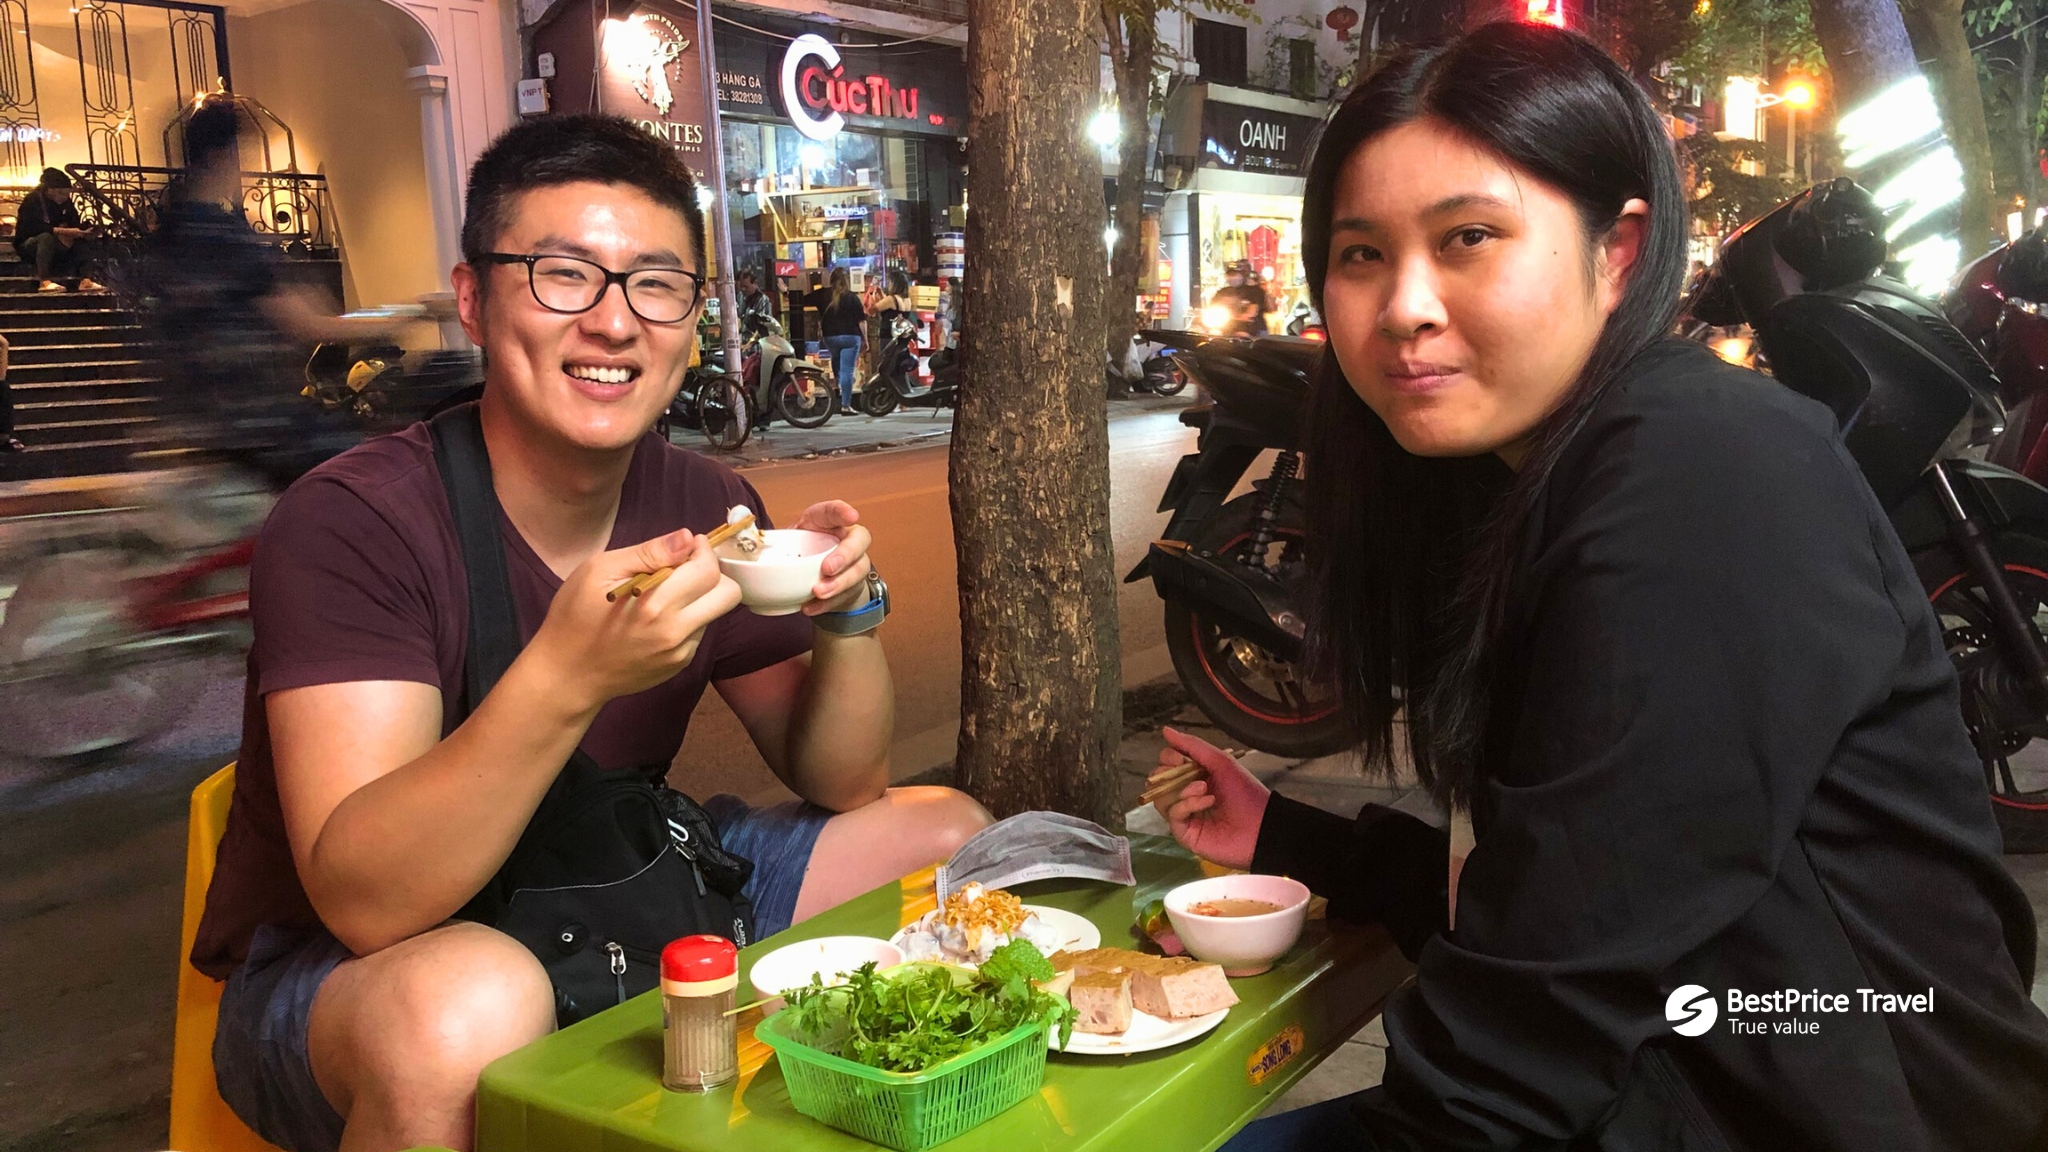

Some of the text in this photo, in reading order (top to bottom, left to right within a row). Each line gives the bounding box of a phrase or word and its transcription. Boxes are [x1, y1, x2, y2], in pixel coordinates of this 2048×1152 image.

[722, 71, 747, 87] HÀNG
[748, 75, 761, 89] GÀ
[522, 88, 542, 97] VNPT
[633, 119, 703, 144] ONTES
[1239, 119, 1287, 151] OANH
